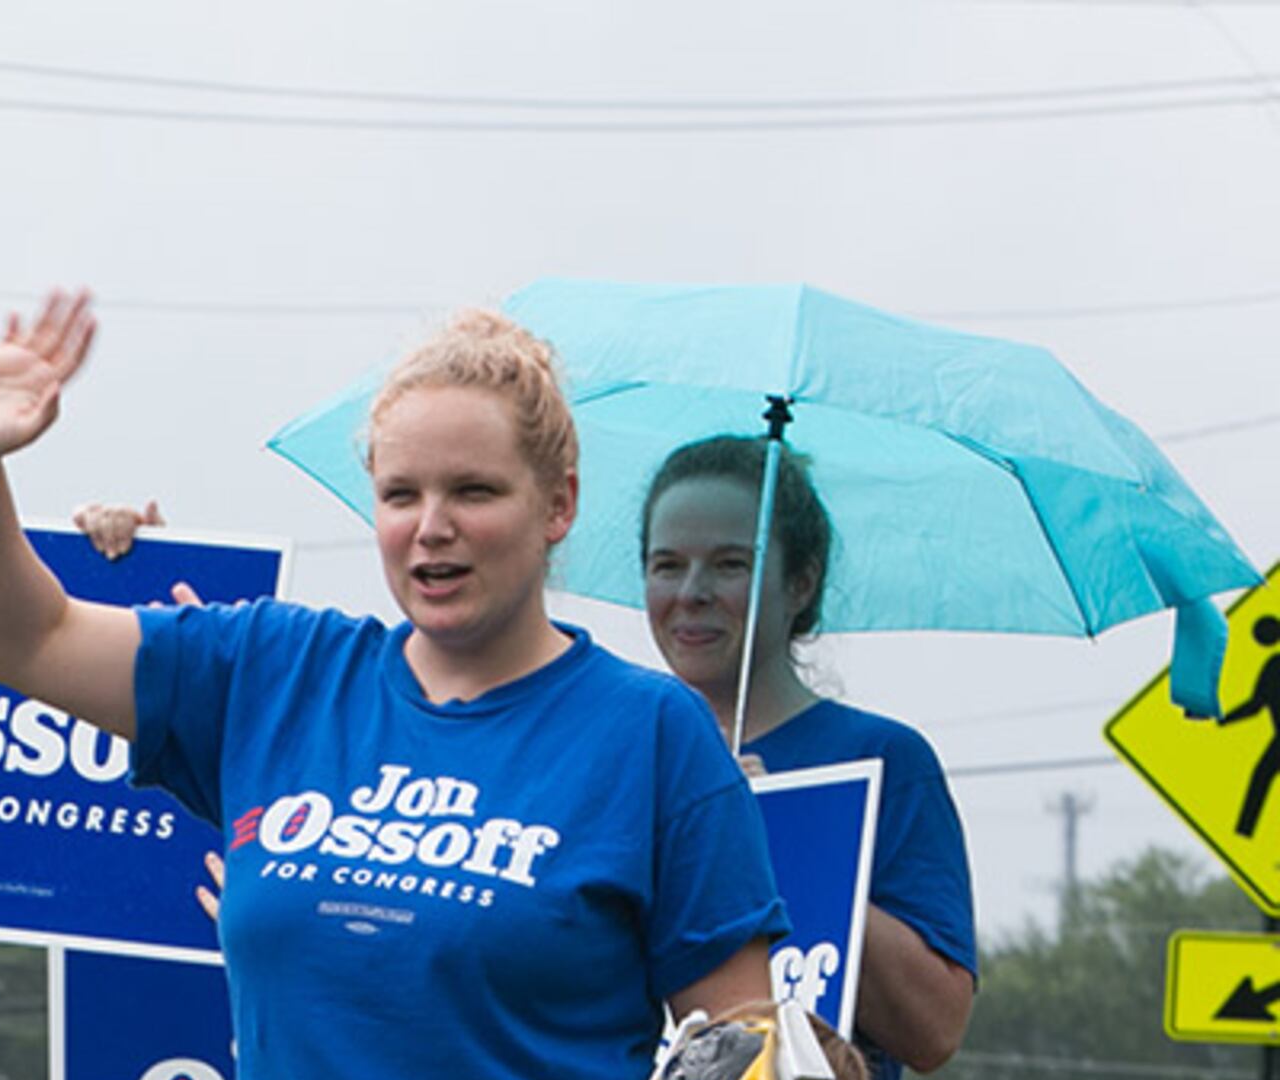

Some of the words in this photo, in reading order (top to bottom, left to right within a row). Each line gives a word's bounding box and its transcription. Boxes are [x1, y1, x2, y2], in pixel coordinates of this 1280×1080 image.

[350, 763, 479, 818] Jon
[258, 790, 560, 887] Ossoff
[332, 866, 495, 907] CONGRESS
